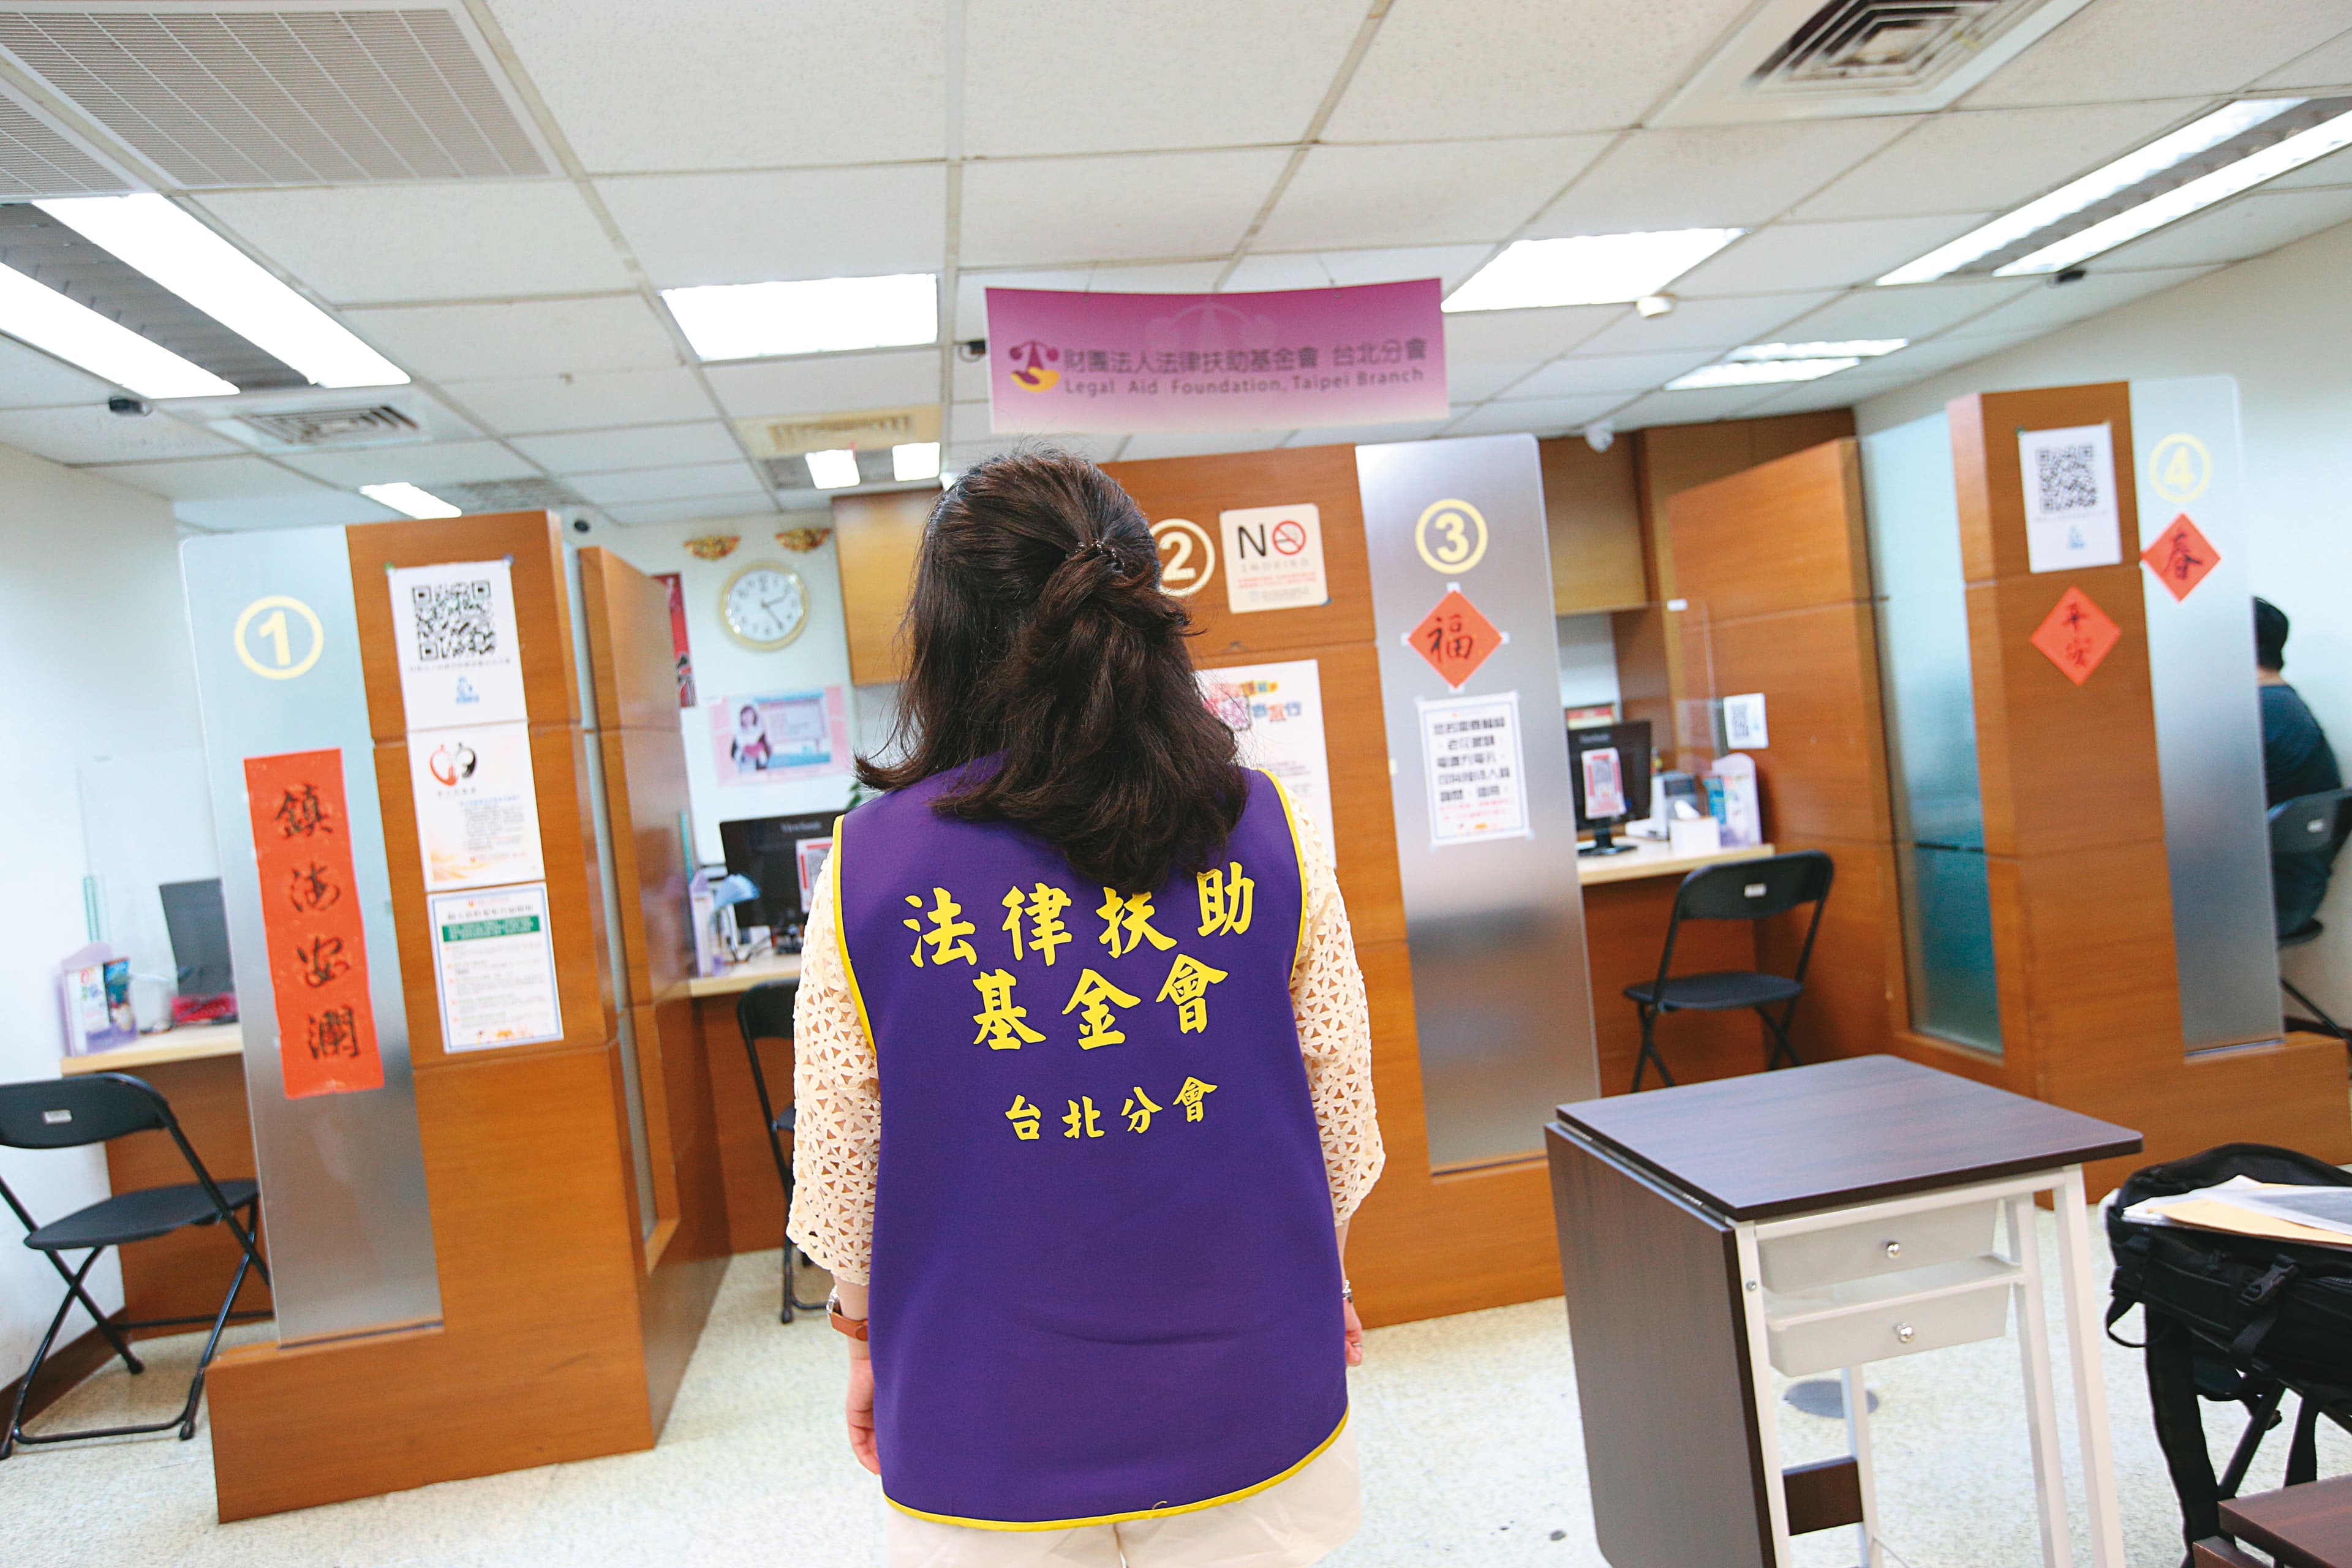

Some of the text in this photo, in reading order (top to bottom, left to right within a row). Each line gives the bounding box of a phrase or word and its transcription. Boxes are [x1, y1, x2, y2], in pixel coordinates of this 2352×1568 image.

[1063, 338, 1427, 374] 財團法人法律扶助基金會 台北分會
[1065, 379, 1115, 398] Legal
[1128, 378, 1159, 395] Aid
[1292, 374, 1349, 392] Taipei
[1356, 368, 1424, 386] Branch
[1427, 614, 1473, 663] 福
[903, 861, 1255, 968] 法律扶助
[972, 953, 1229, 1051] 基金會
[1005, 1076, 1218, 1141] 台北分會
